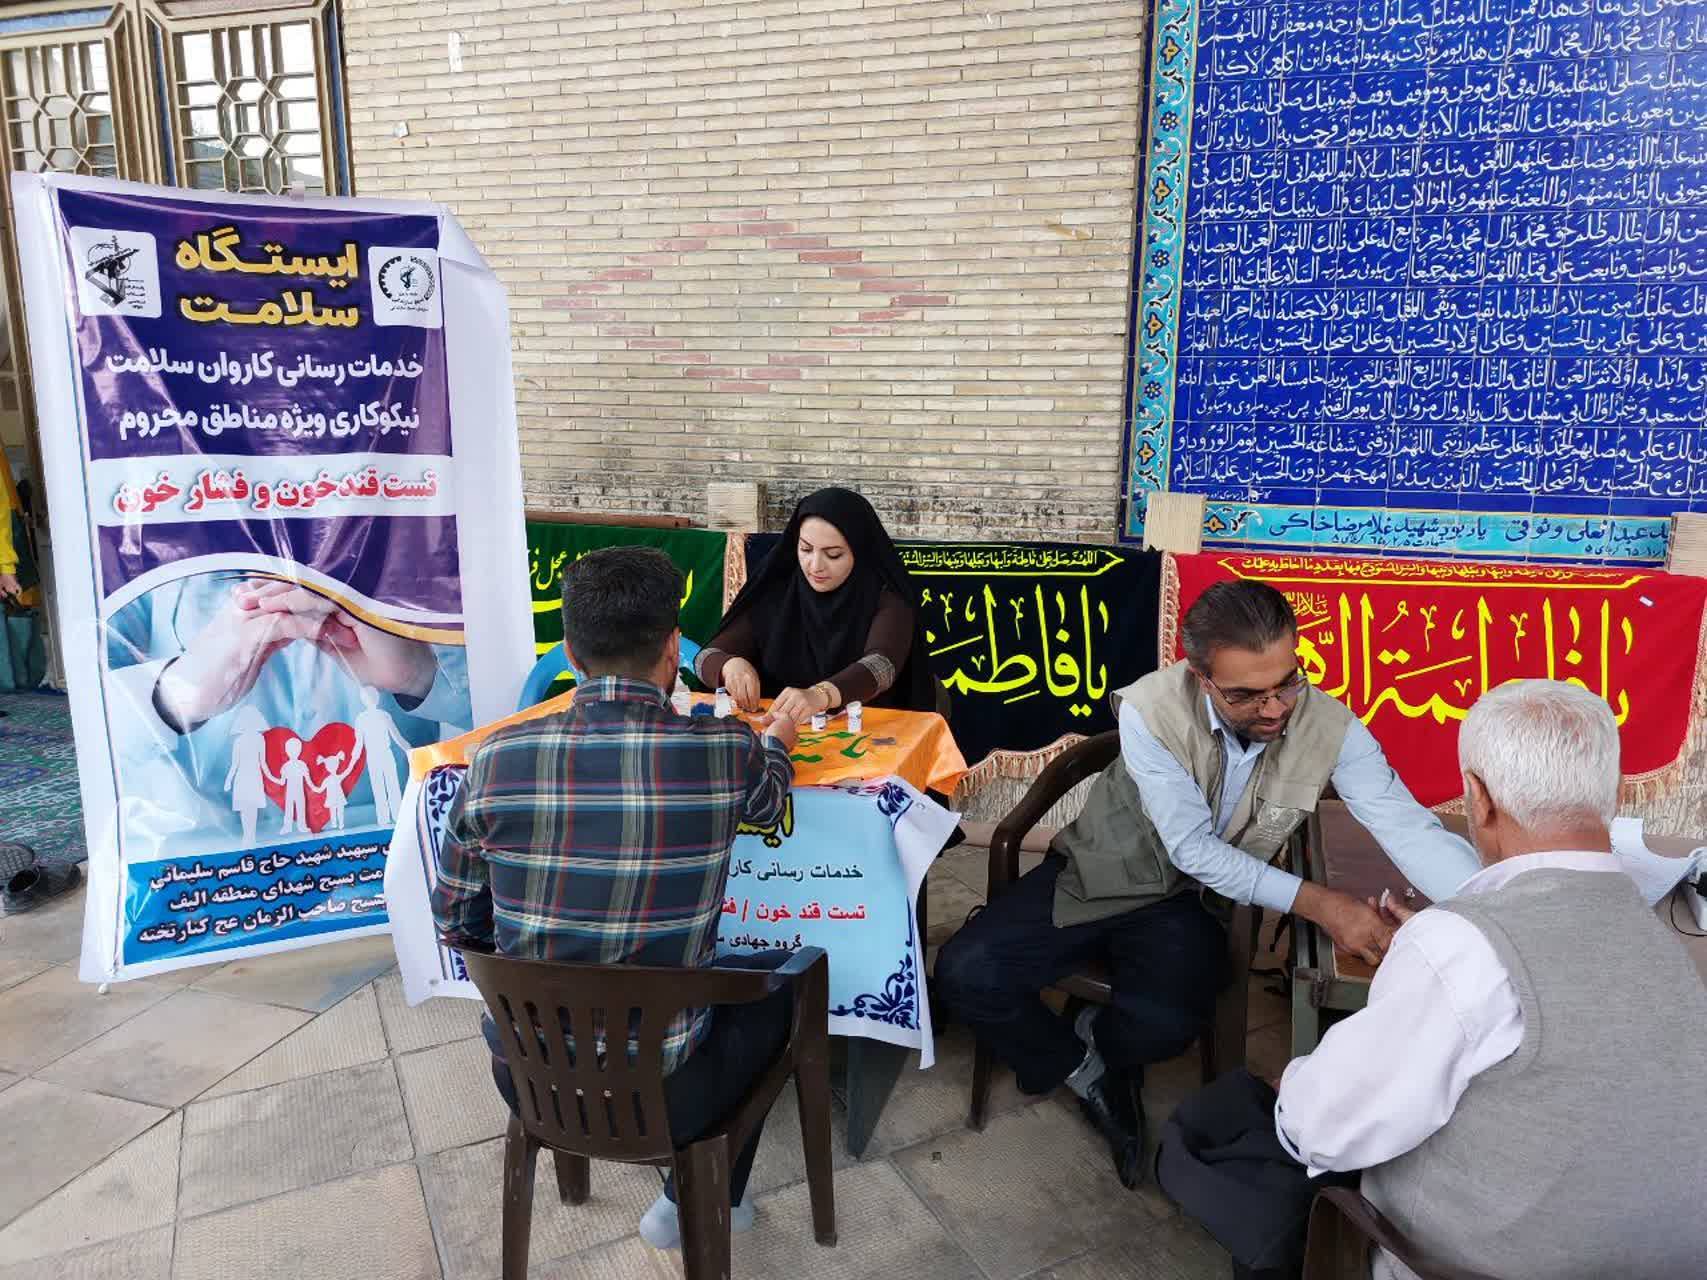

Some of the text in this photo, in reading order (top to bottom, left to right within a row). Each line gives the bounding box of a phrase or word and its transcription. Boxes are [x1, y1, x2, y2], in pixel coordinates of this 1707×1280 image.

[175, 227, 359, 288] ایستگاه
[180, 291, 359, 328] سلامت
[105, 348, 423, 387] خدمات رسانی کاروان سلامت
[119, 401, 420, 440] نیکوکاری ویژه مناطق محروم
[114, 468, 438, 514] تست قند خون و فشار خون
[259, 854, 291, 874] حاج
[295, 845, 333, 866] شهید
[150, 864, 213, 893] سلیمانی
[218, 858, 254, 880] قاسم
[757, 862, 803, 881] رسانی
[810, 864, 863, 879] خدمات
[262, 875, 314, 901] شهدای
[319, 873, 355, 891] بسیج
[211, 886, 258, 903] منطقه
[243, 905, 293, 930] الزمان
[757, 902, 791, 923] خون
[799, 901, 821, 920] قند
[828, 904, 865, 920] تست
[729, 933, 769, 950] جهادی
[775, 934, 802, 950] گروه
